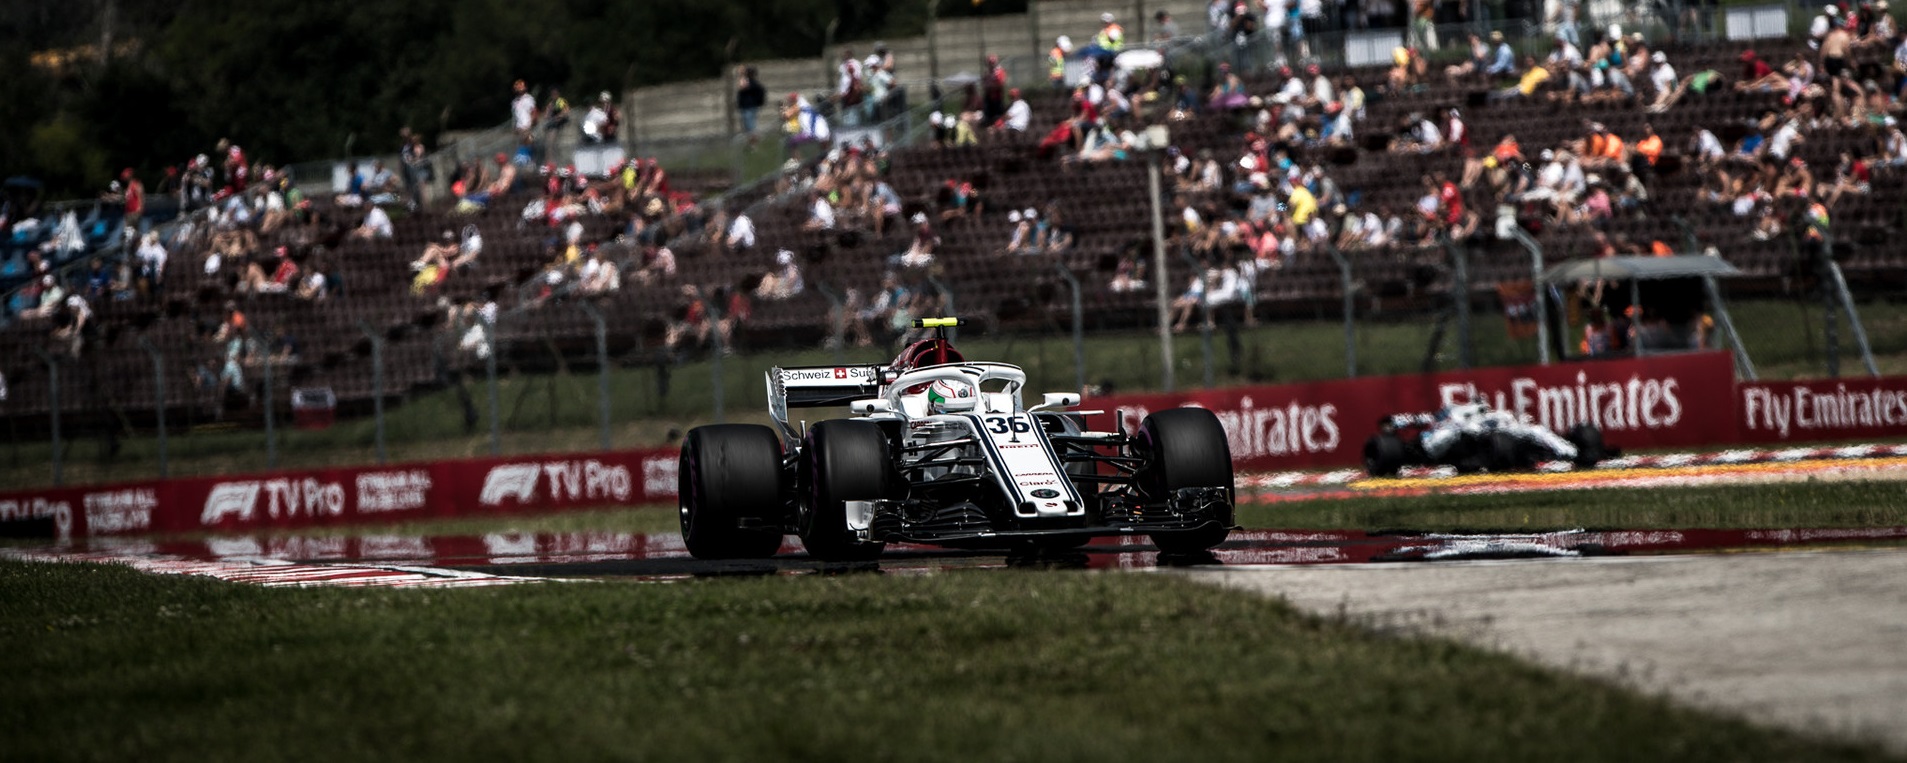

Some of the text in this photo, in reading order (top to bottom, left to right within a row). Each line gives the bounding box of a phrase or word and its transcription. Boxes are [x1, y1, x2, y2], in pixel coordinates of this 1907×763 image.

[783, 369, 831, 381] Schweiz
[1511, 369, 1682, 433] Emirates
[1743, 382, 1907, 438] Fly Emirates
[985, 416, 1031, 434] 36
[264, 477, 301, 519] TV
[302, 477, 346, 516] Pro
[544, 460, 581, 500] TV
[584, 458, 632, 501] Pro
